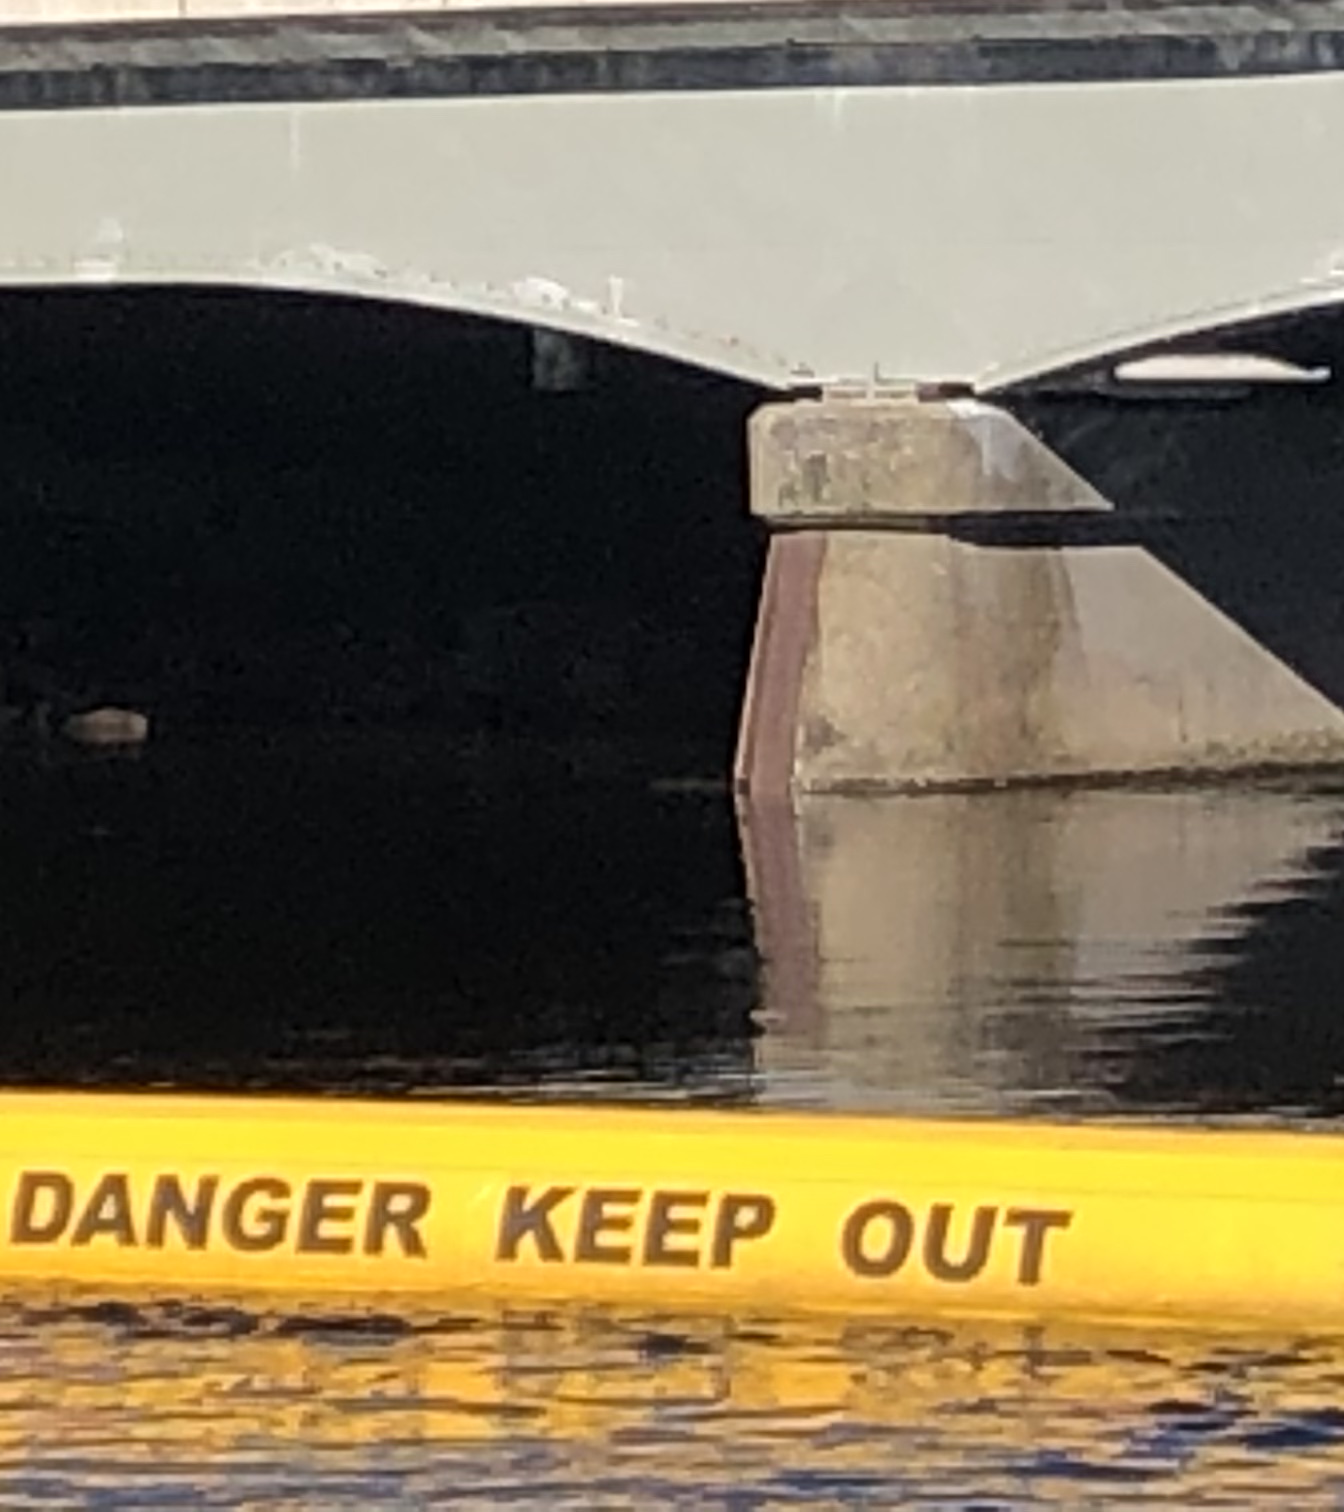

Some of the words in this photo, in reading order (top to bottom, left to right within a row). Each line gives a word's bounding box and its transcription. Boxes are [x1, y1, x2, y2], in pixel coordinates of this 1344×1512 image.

[10, 1171, 432, 1257] DANGER
[496, 1185, 777, 1269] KEEP
[842, 1200, 1073, 1287] OUT
